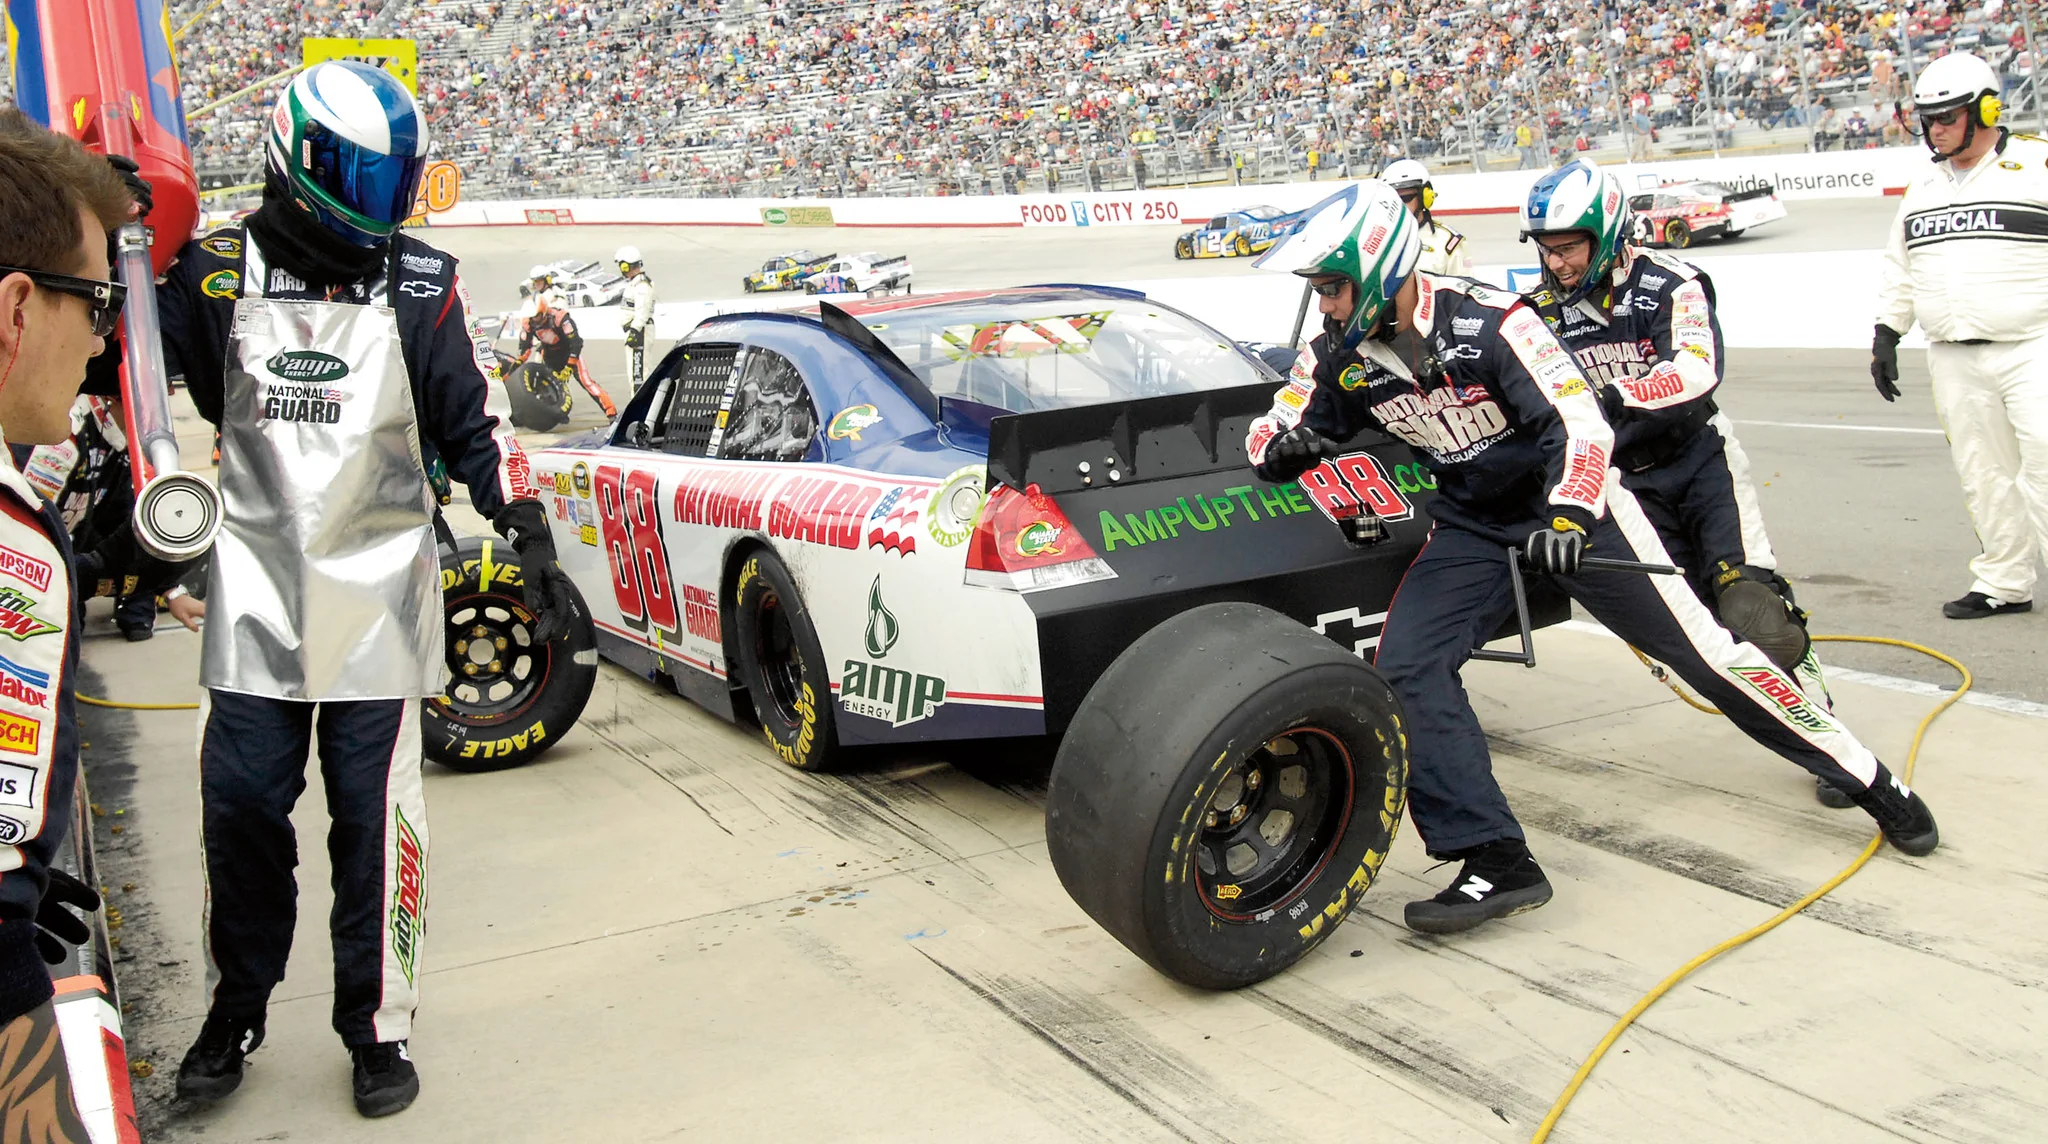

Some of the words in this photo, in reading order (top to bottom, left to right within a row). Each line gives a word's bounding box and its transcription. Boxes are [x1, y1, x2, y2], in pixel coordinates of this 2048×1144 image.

[1775, 172, 1874, 191] Insurance
[1020, 204, 1067, 223] FOOD
[1093, 202, 1132, 222] CITY
[1142, 201, 1178, 220] 250
[1911, 210, 2005, 237] OFFICIAL
[1208, 231, 1221, 252] 2
[1366, 226, 1388, 256] GUARD
[401, 252, 443, 268] Hendrick
[284, 358, 341, 377] amp
[268, 384, 325, 400] NATIONAL
[265, 397, 341, 424] GUARD
[1558, 453, 1588, 498] NATIONAL
[1571, 443, 1605, 506] GUARD
[554, 496, 569, 522] 3M
[673, 468, 778, 531] NATIONAL
[768, 474, 882, 550] GUARD
[593, 464, 678, 632] 88
[736, 558, 758, 607] EAGLE
[685, 600, 723, 644] GUARD
[841, 659, 946, 723] amp
[844, 700, 892, 720] ENERGY
[460, 720, 547, 758] EAGLE
